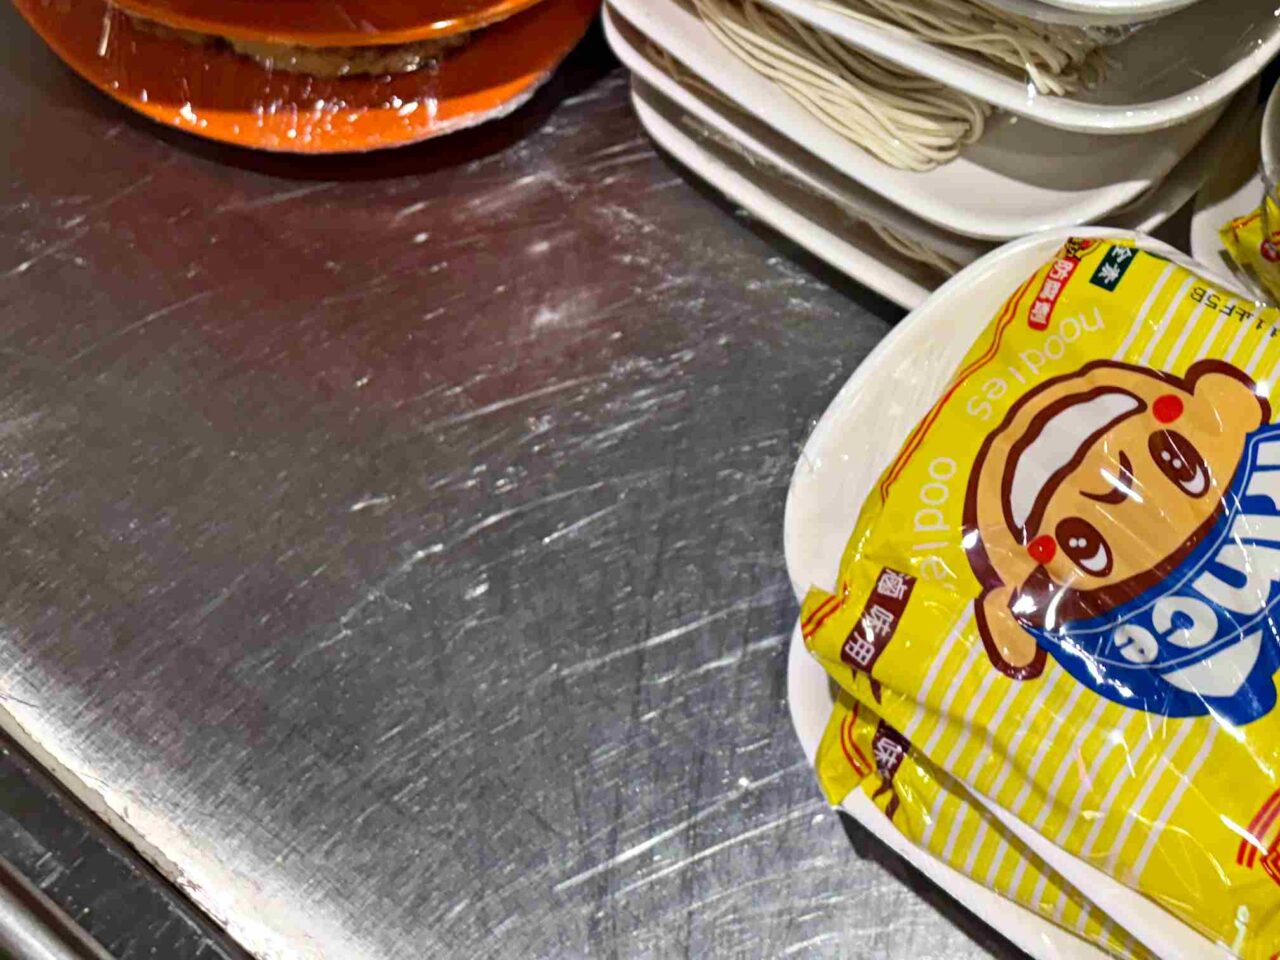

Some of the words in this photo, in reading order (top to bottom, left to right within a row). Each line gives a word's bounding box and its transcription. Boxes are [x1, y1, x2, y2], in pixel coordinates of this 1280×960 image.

[1098, 246, 1132, 284] 全素
[966, 306, 1104, 421] noodles
[844, 568, 911, 666] 滷味用
